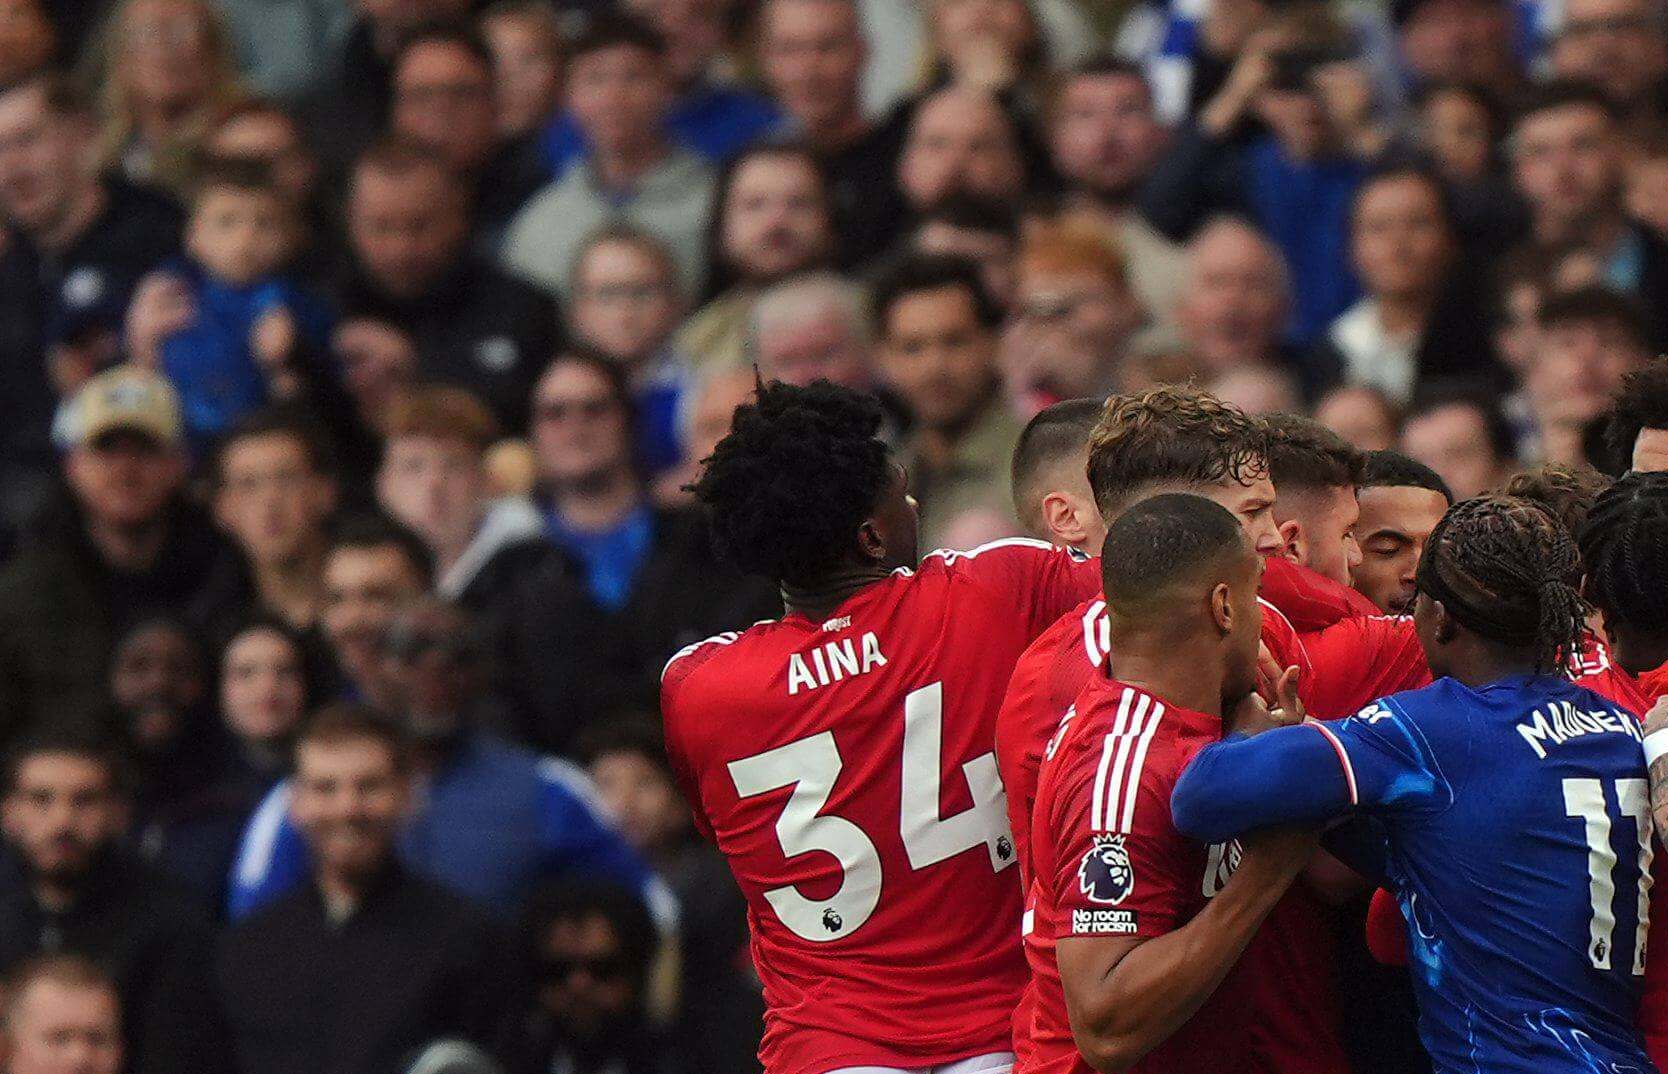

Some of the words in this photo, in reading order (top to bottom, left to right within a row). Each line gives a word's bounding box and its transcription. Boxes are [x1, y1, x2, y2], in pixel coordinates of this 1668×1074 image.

[788, 631, 888, 695] AINA
[1516, 701, 1644, 760] MADUEK
[727, 681, 1017, 942] 34
[1562, 778, 1654, 976] 11
[1072, 909, 1092, 922] No
[1093, 911, 1132, 922] room
[1072, 921, 1091, 934] for
[1092, 922, 1138, 934] racism
